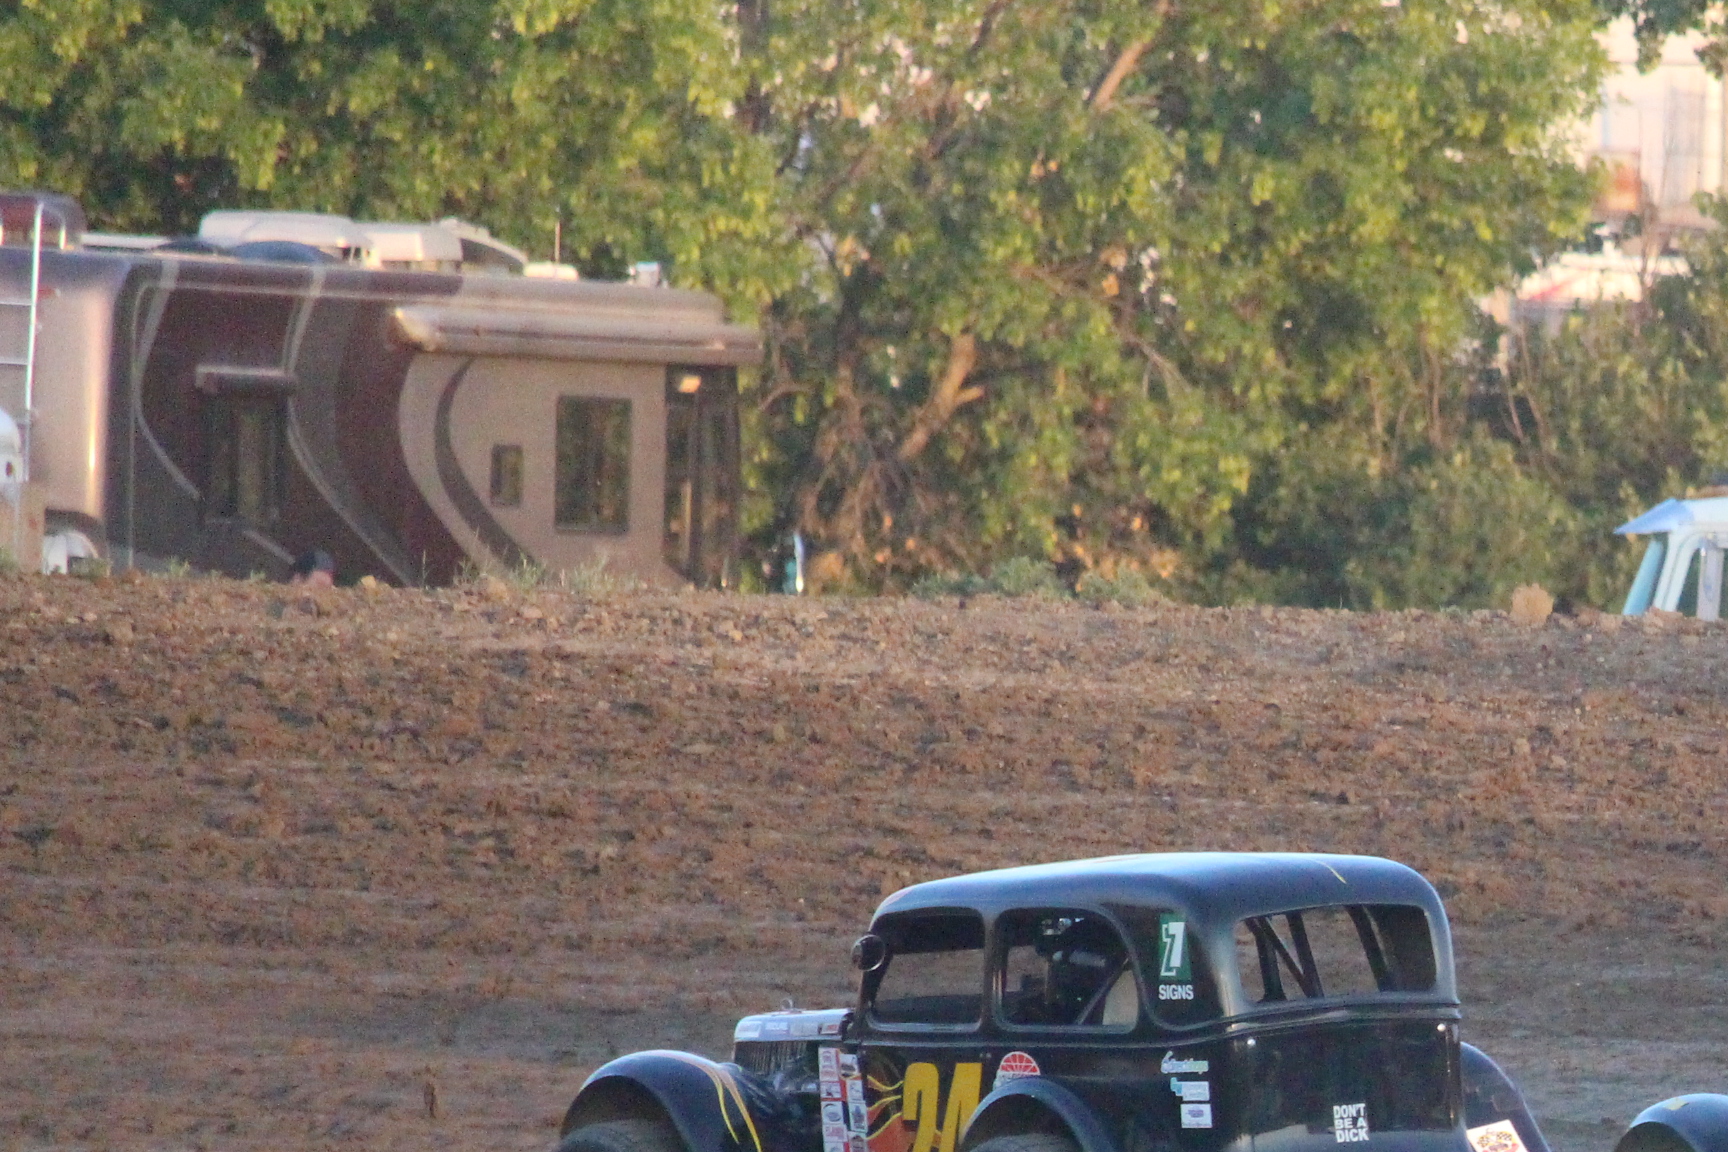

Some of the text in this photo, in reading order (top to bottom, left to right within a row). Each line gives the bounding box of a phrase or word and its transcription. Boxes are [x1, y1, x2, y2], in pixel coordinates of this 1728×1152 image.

[1159, 985, 1194, 1000] SIGNS
[1333, 1103, 1366, 1118] DON'T
[1334, 1117, 1367, 1129] BE A
[1336, 1128, 1369, 1142] DICK
